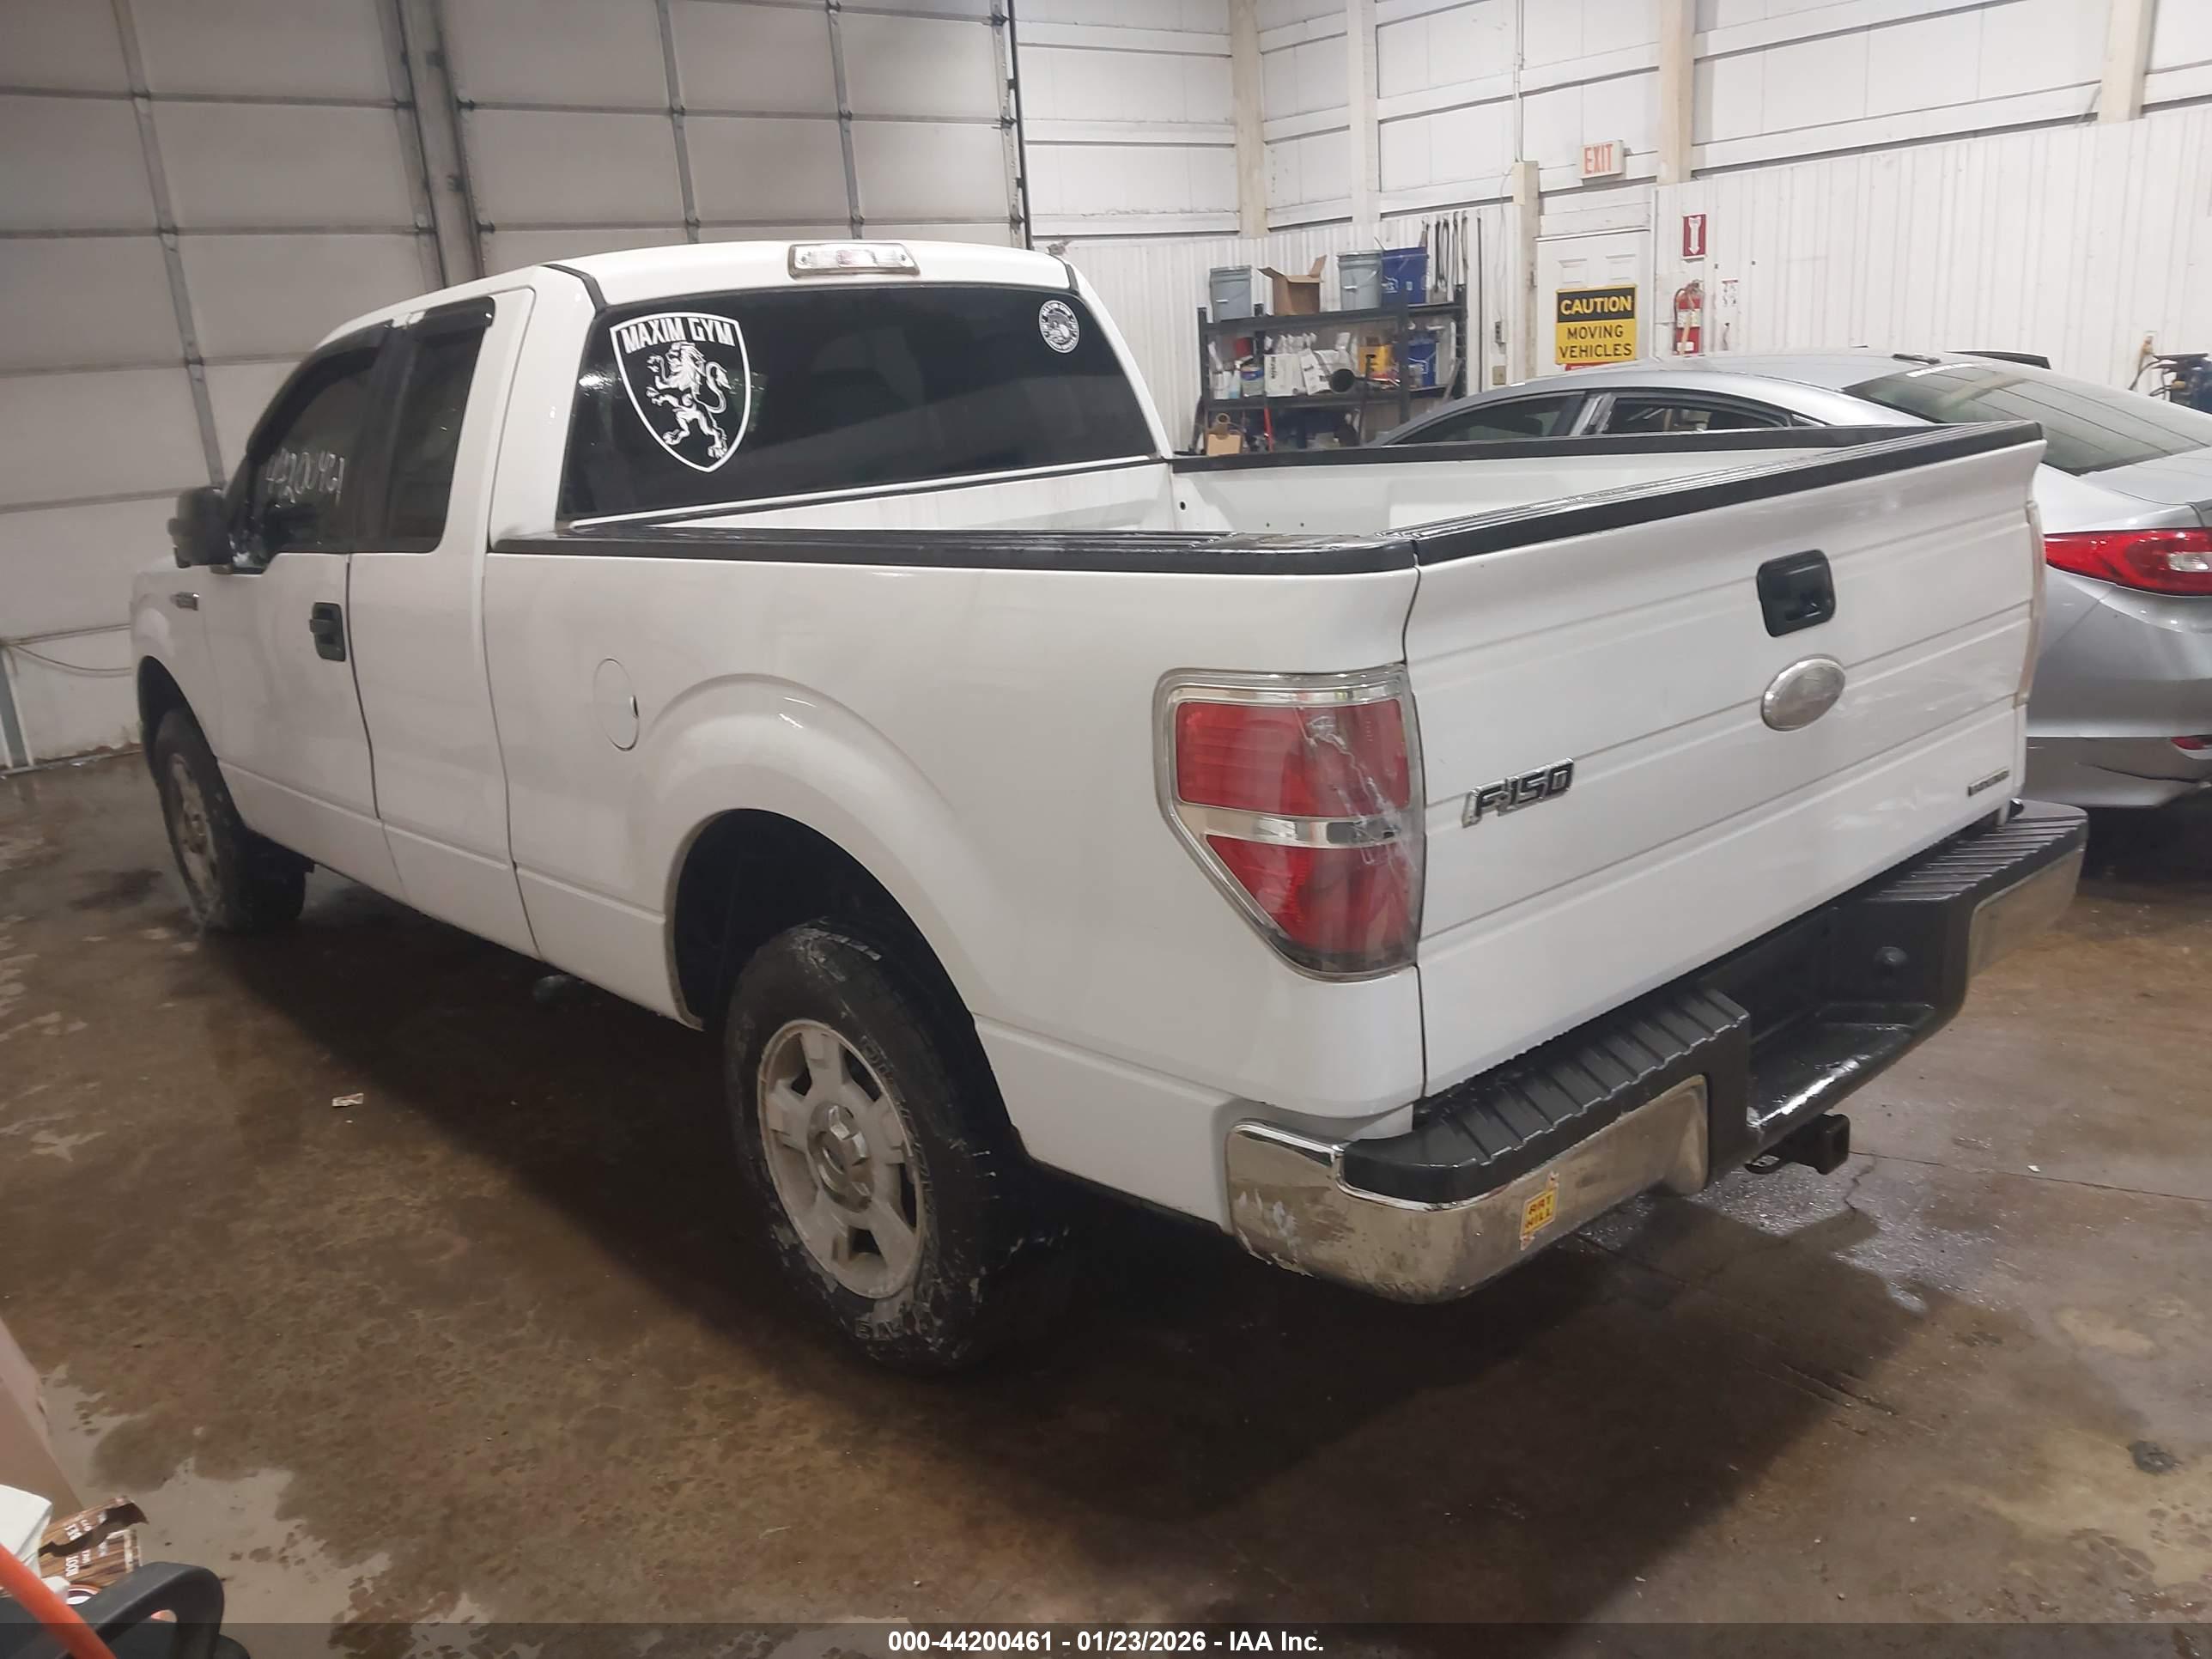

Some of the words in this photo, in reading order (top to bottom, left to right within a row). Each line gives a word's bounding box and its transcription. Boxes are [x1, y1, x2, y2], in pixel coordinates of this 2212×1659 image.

[1583, 143, 1613, 174] EXIT
[1559, 295, 1632, 316] CAUTION
[620, 318, 687, 354] MAXIM
[688, 318, 736, 347] GYM
[1566, 324, 1624, 341] MOVING
[1559, 343, 1633, 360] VEHICLES
